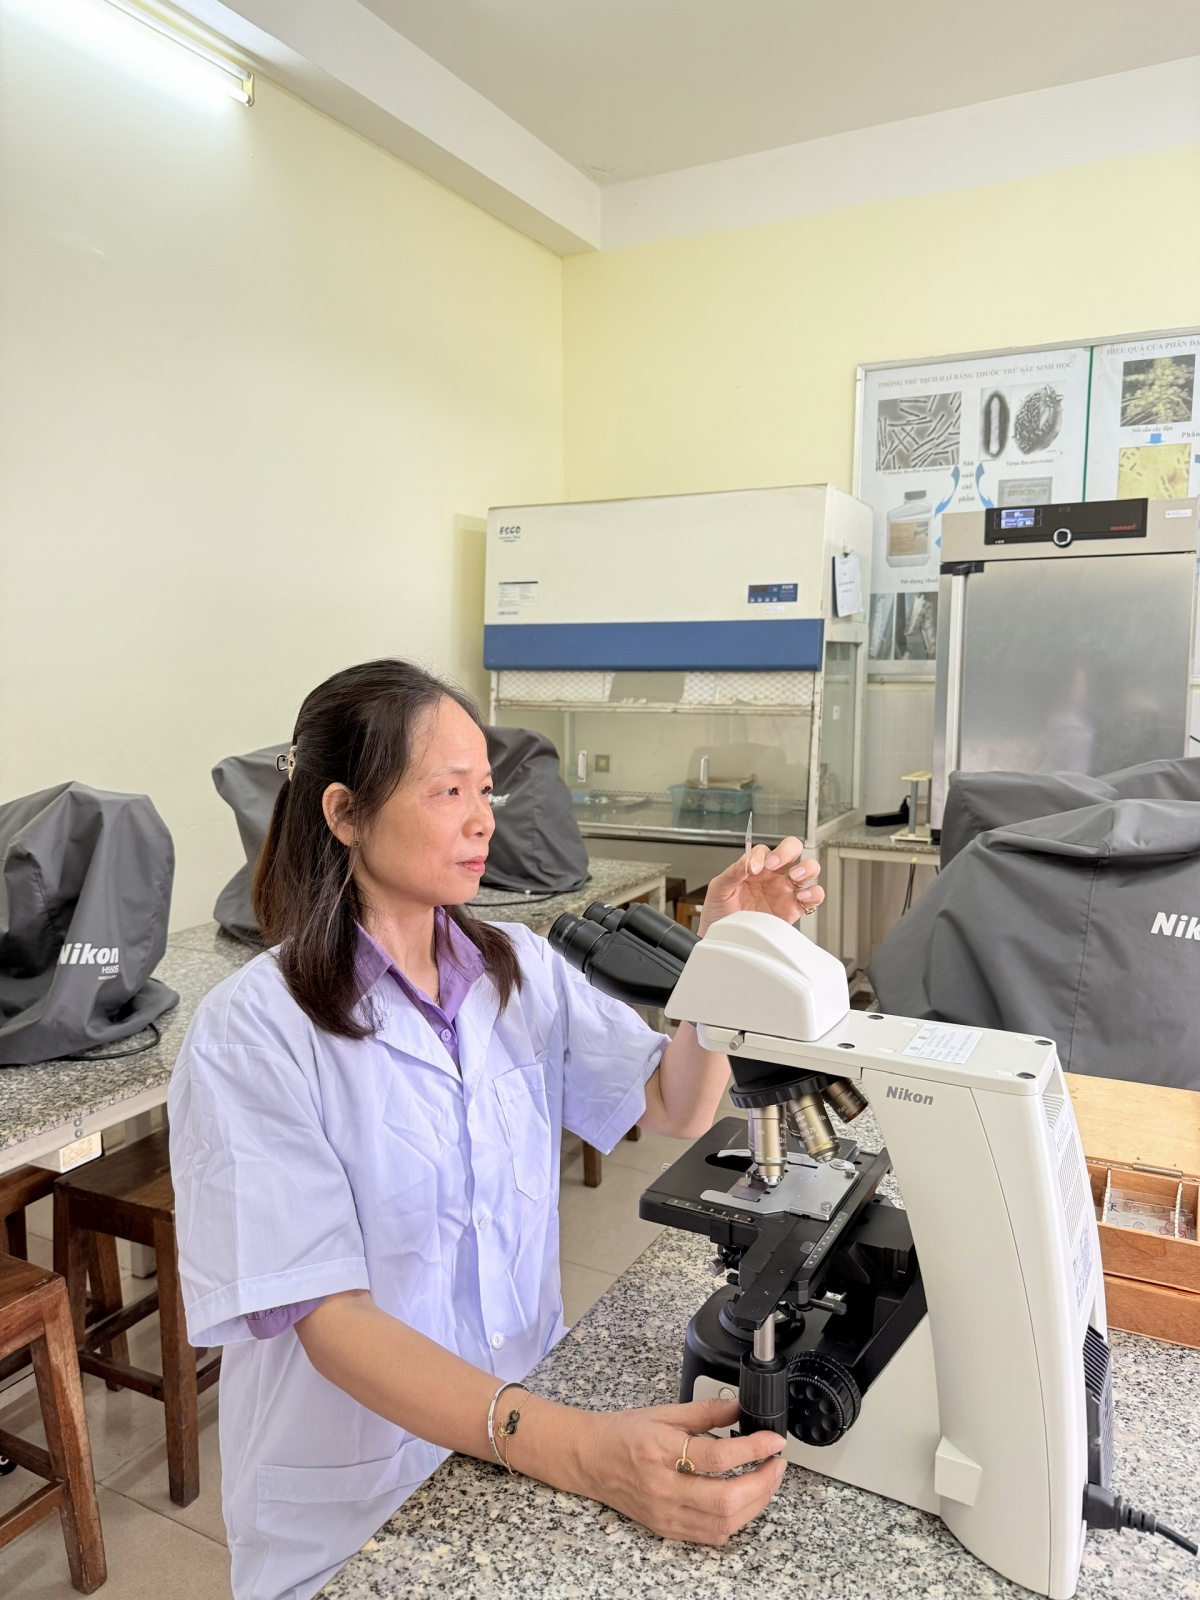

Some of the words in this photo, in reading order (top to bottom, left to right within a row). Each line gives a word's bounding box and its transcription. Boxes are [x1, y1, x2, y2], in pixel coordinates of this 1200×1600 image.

[1150, 911, 1200, 941] Nik
[58, 943, 119, 965] Nikon
[886, 1085, 934, 1106] Nikon
